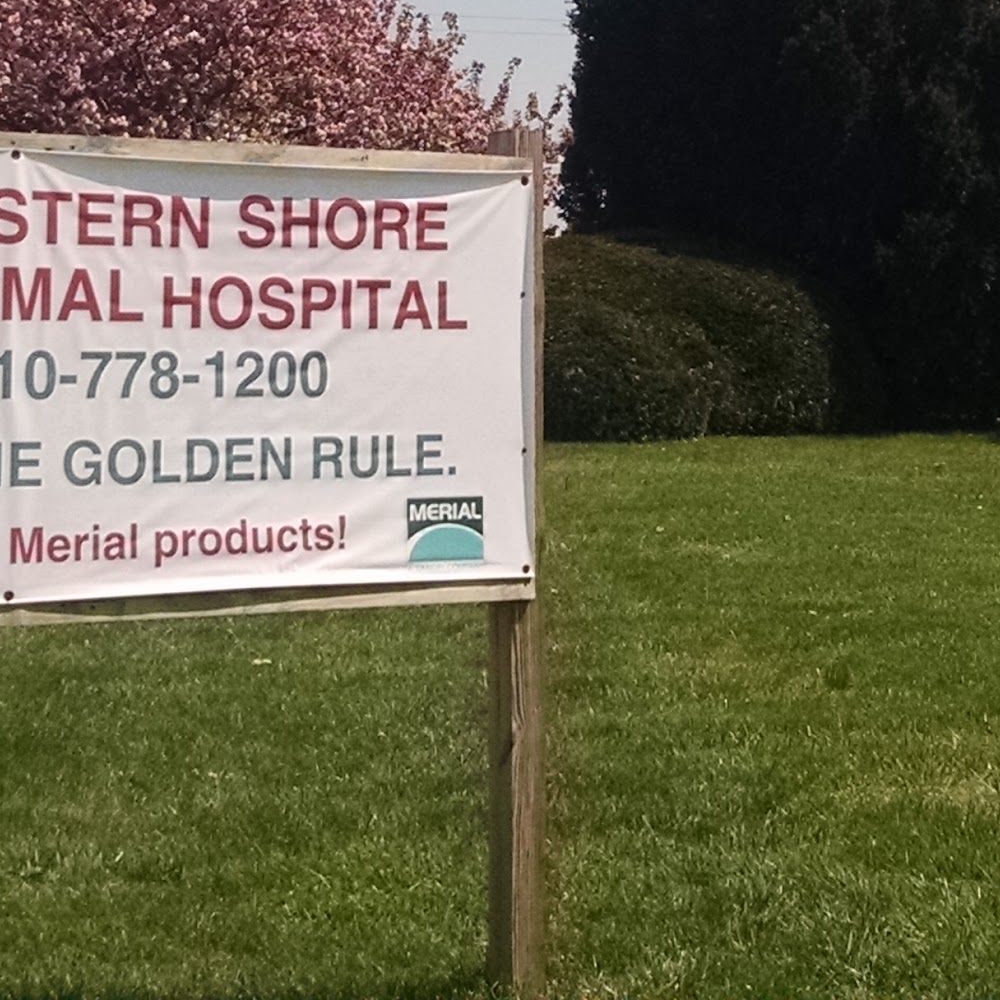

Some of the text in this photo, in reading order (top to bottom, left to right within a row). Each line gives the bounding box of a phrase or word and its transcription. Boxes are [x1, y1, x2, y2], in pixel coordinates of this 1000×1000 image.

[0, 188, 448, 251] STERN SHORE
[2, 267, 468, 330] MAL HOSPITAL
[0, 349, 328, 400] 10-778-1200
[0, 433, 456, 487] E GOLDEN RULE.
[409, 502, 482, 521] MERIAL
[9, 516, 347, 567] Merial products!
